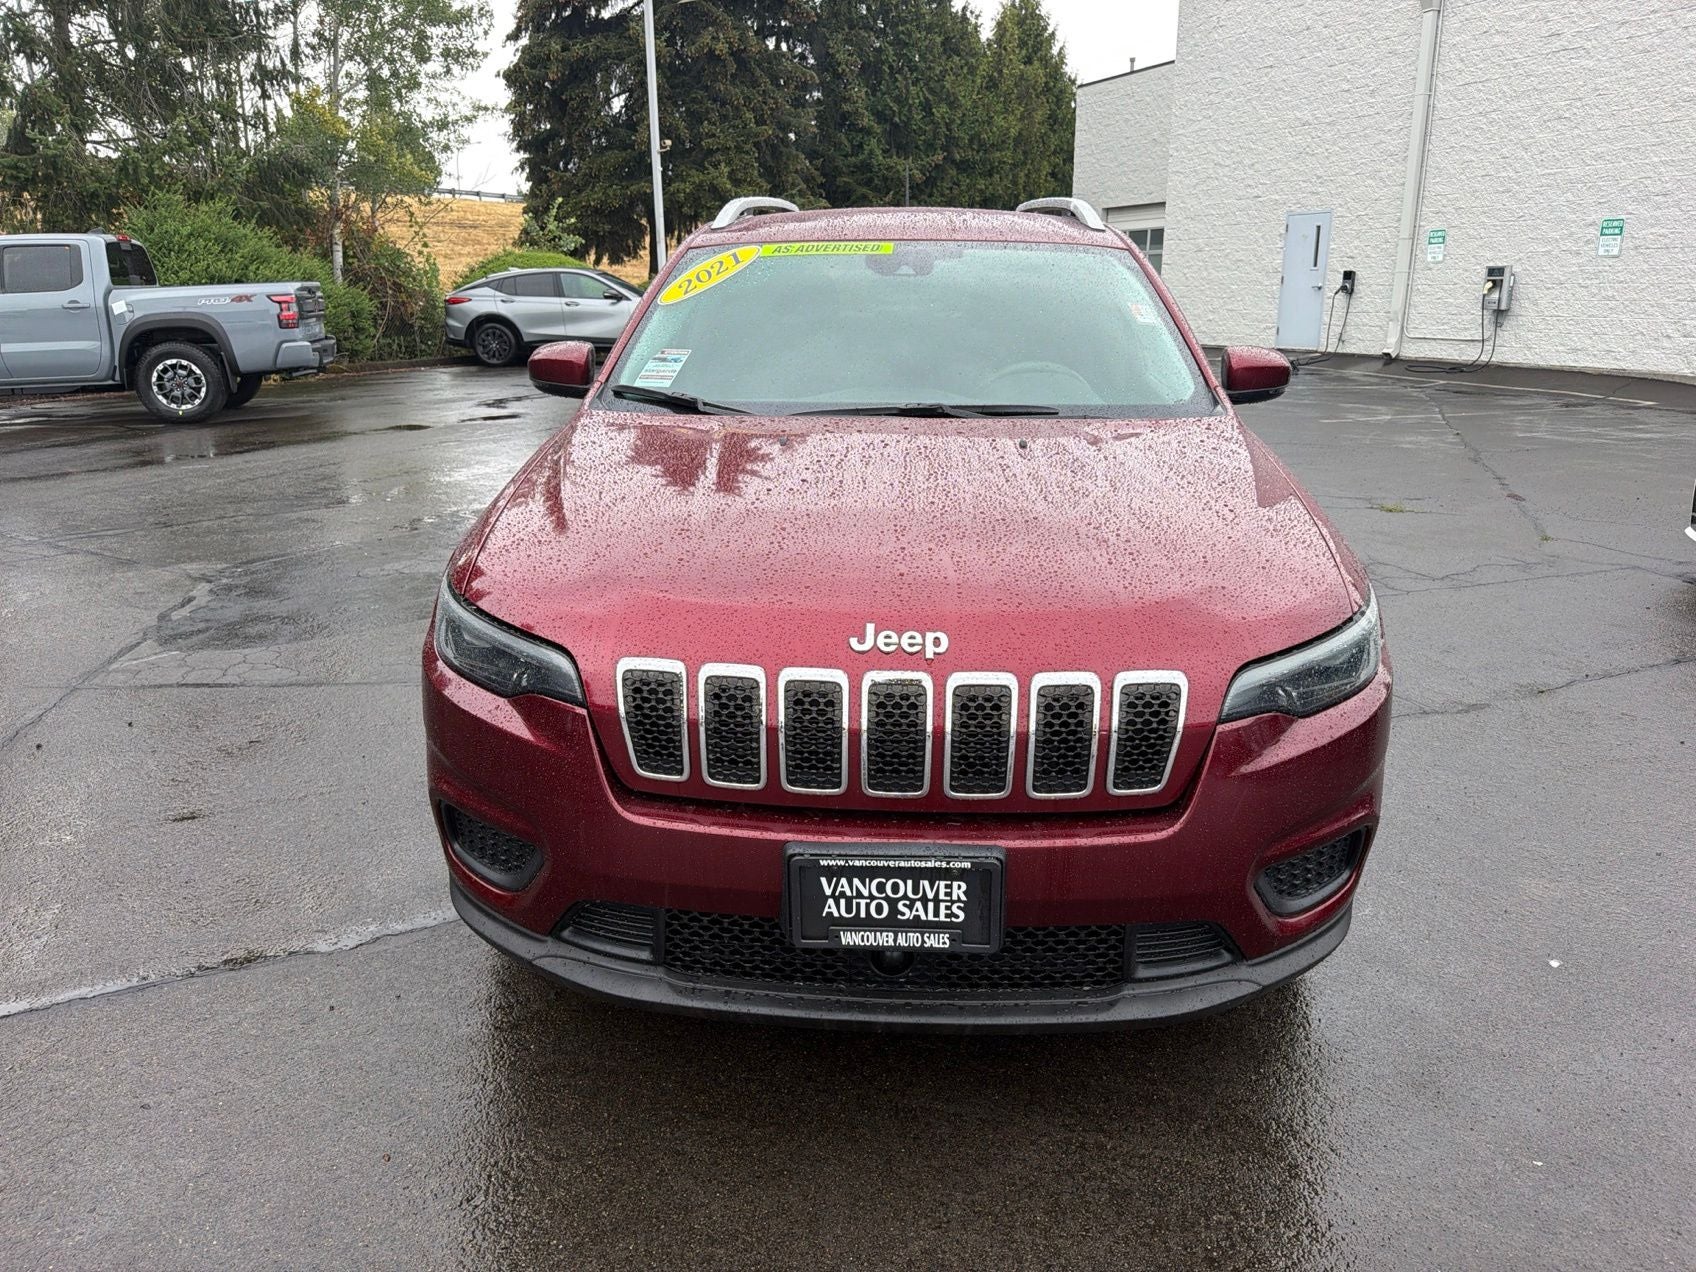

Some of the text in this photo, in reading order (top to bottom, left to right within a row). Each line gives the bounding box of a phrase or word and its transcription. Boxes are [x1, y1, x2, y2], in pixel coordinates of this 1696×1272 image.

[1602, 227, 1622, 235] PARKING
[794, 243, 882, 253] ADVERTISED
[678, 251, 744, 296] 2021
[849, 622, 949, 659] Jeep
[819, 859, 972, 869] www.vancouverautosales.com
[820, 876, 968, 901] VANCOUVER
[822, 898, 966, 923] AUTO SALES
[840, 931, 950, 949] VANCOUVER AUTO SALES
